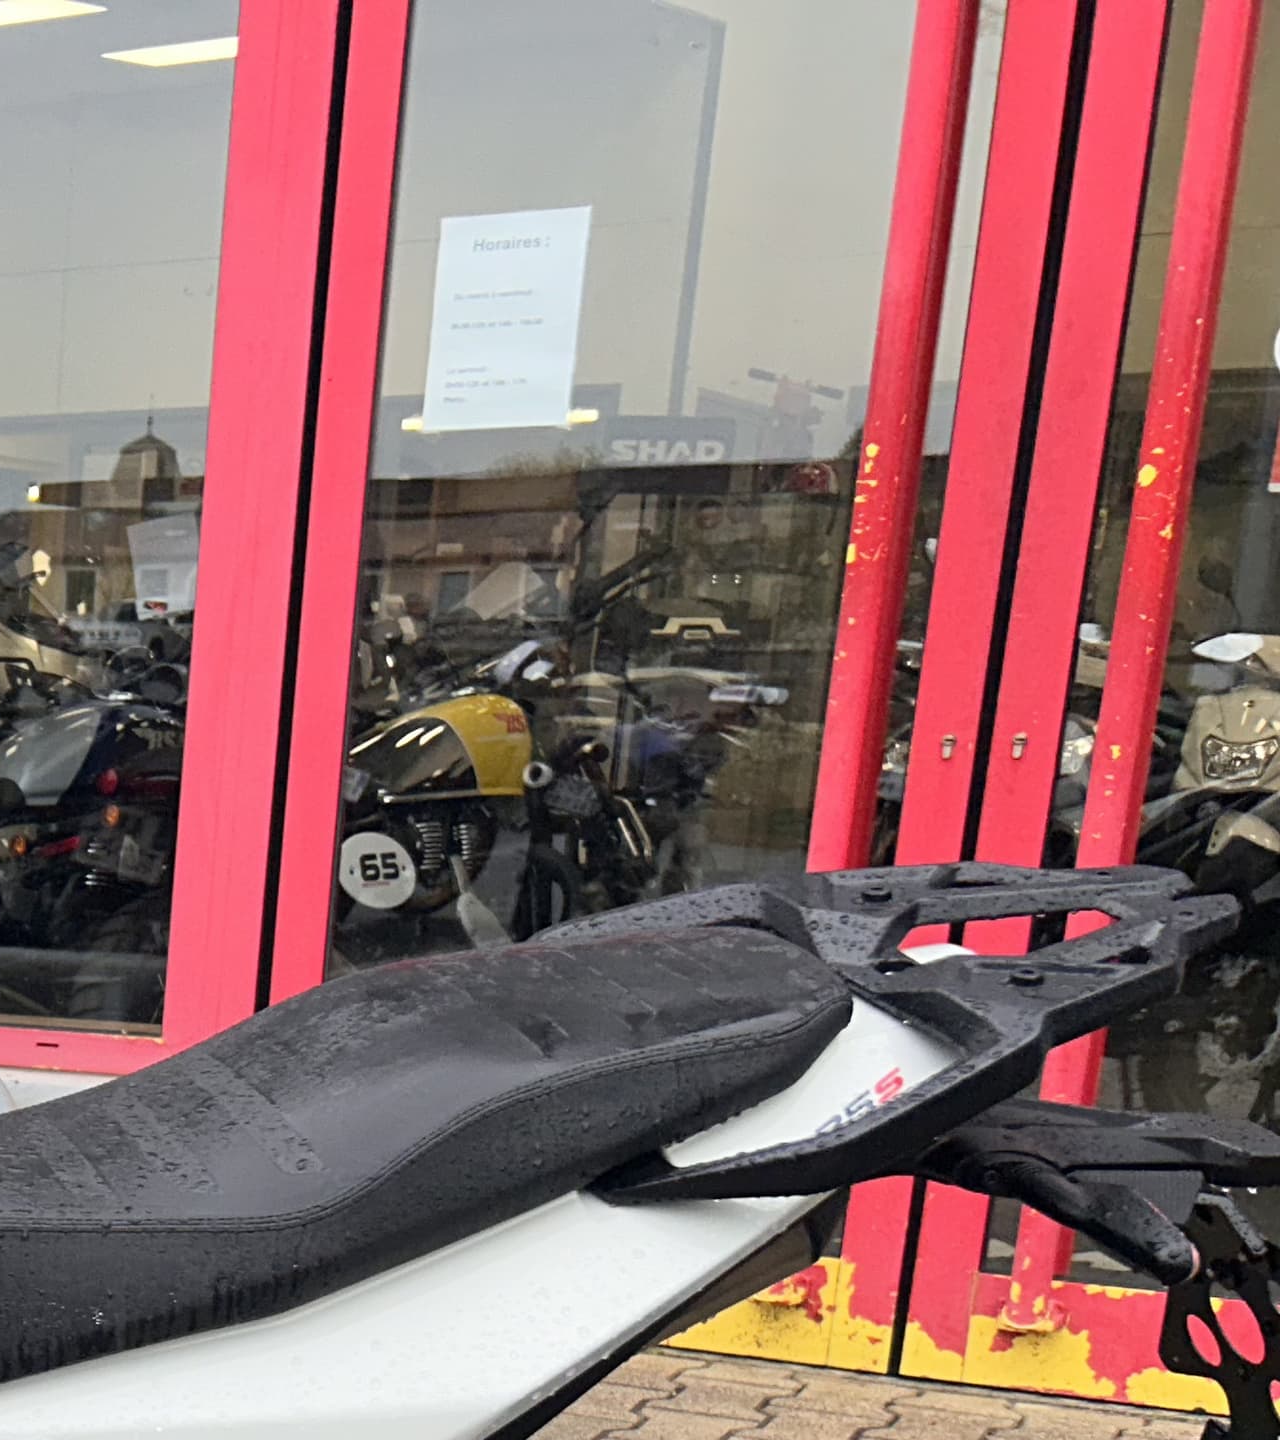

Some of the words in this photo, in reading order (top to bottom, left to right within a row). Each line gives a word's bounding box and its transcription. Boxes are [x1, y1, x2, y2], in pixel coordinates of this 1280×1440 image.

[472, 237, 541, 253] Horaires
[609, 439, 725, 463] SHAD
[359, 852, 400, 881] 65
